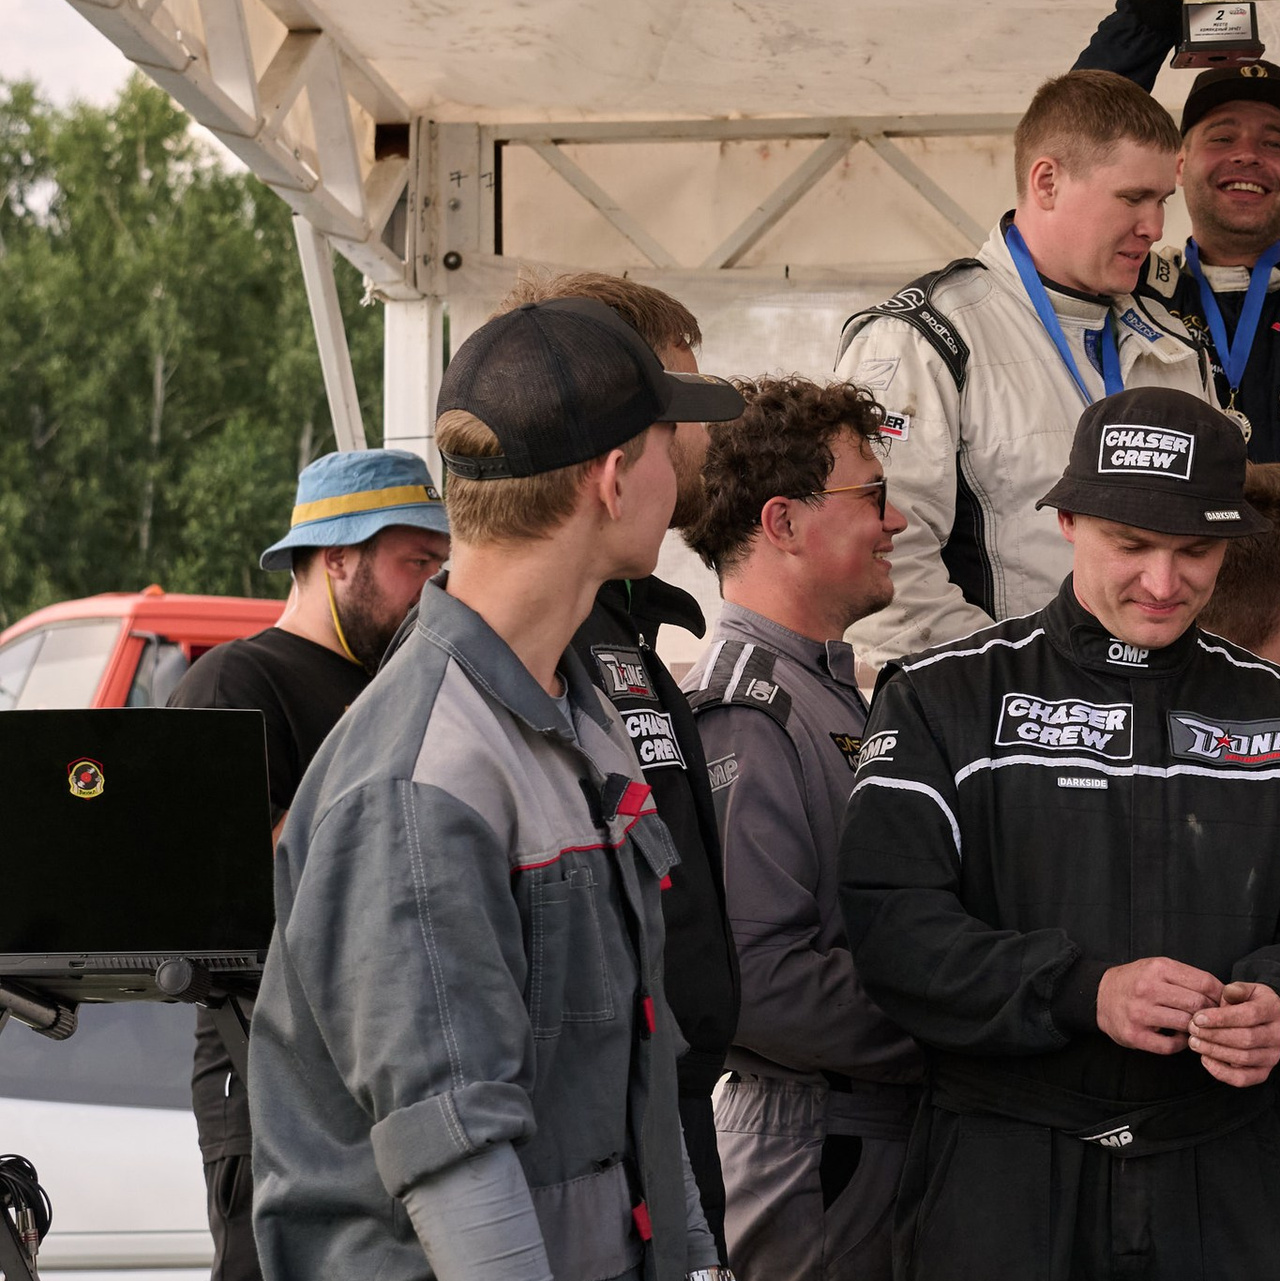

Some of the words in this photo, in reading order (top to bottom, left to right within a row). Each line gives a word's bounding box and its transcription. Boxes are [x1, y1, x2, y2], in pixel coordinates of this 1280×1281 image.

[1216, 10, 1225, 20] 2
[919, 310, 959, 356] sparco
[1124, 311, 1162, 340] sparco
[1105, 430, 1190, 454] CHASER
[1110, 449, 1178, 469] CREW
[1206, 510, 1241, 521] DARKSIDE
[1108, 642, 1149, 664] OMP
[1007, 698, 1127, 731] CHASER
[1016, 721, 1114, 751] CREW
[708, 758, 739, 788] MP
[1058, 777, 1108, 789] DARKSIDE
